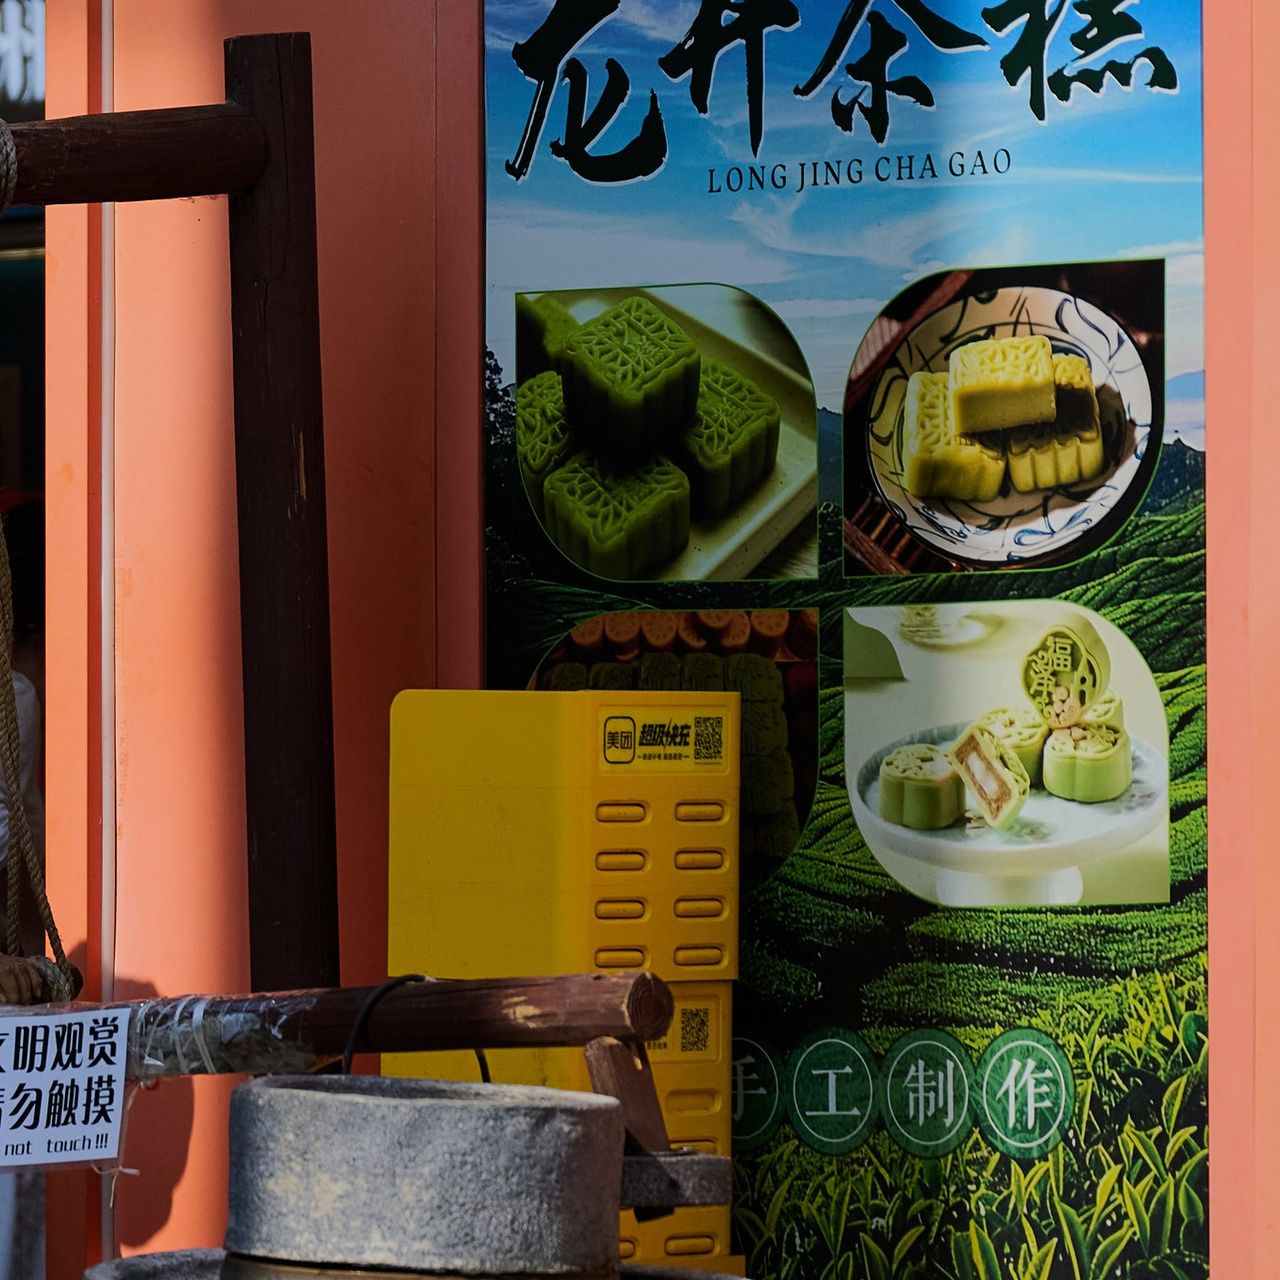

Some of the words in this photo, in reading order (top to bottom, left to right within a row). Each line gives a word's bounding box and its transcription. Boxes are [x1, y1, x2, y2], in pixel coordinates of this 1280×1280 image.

[708, 163, 787, 193] LONG
[796, 158, 863, 192] JING
[874, 153, 938, 182] CHA
[948, 148, 1011, 177] GAO
[607, 730, 633, 750] 美团
[5, 1140, 32, 1156] not
